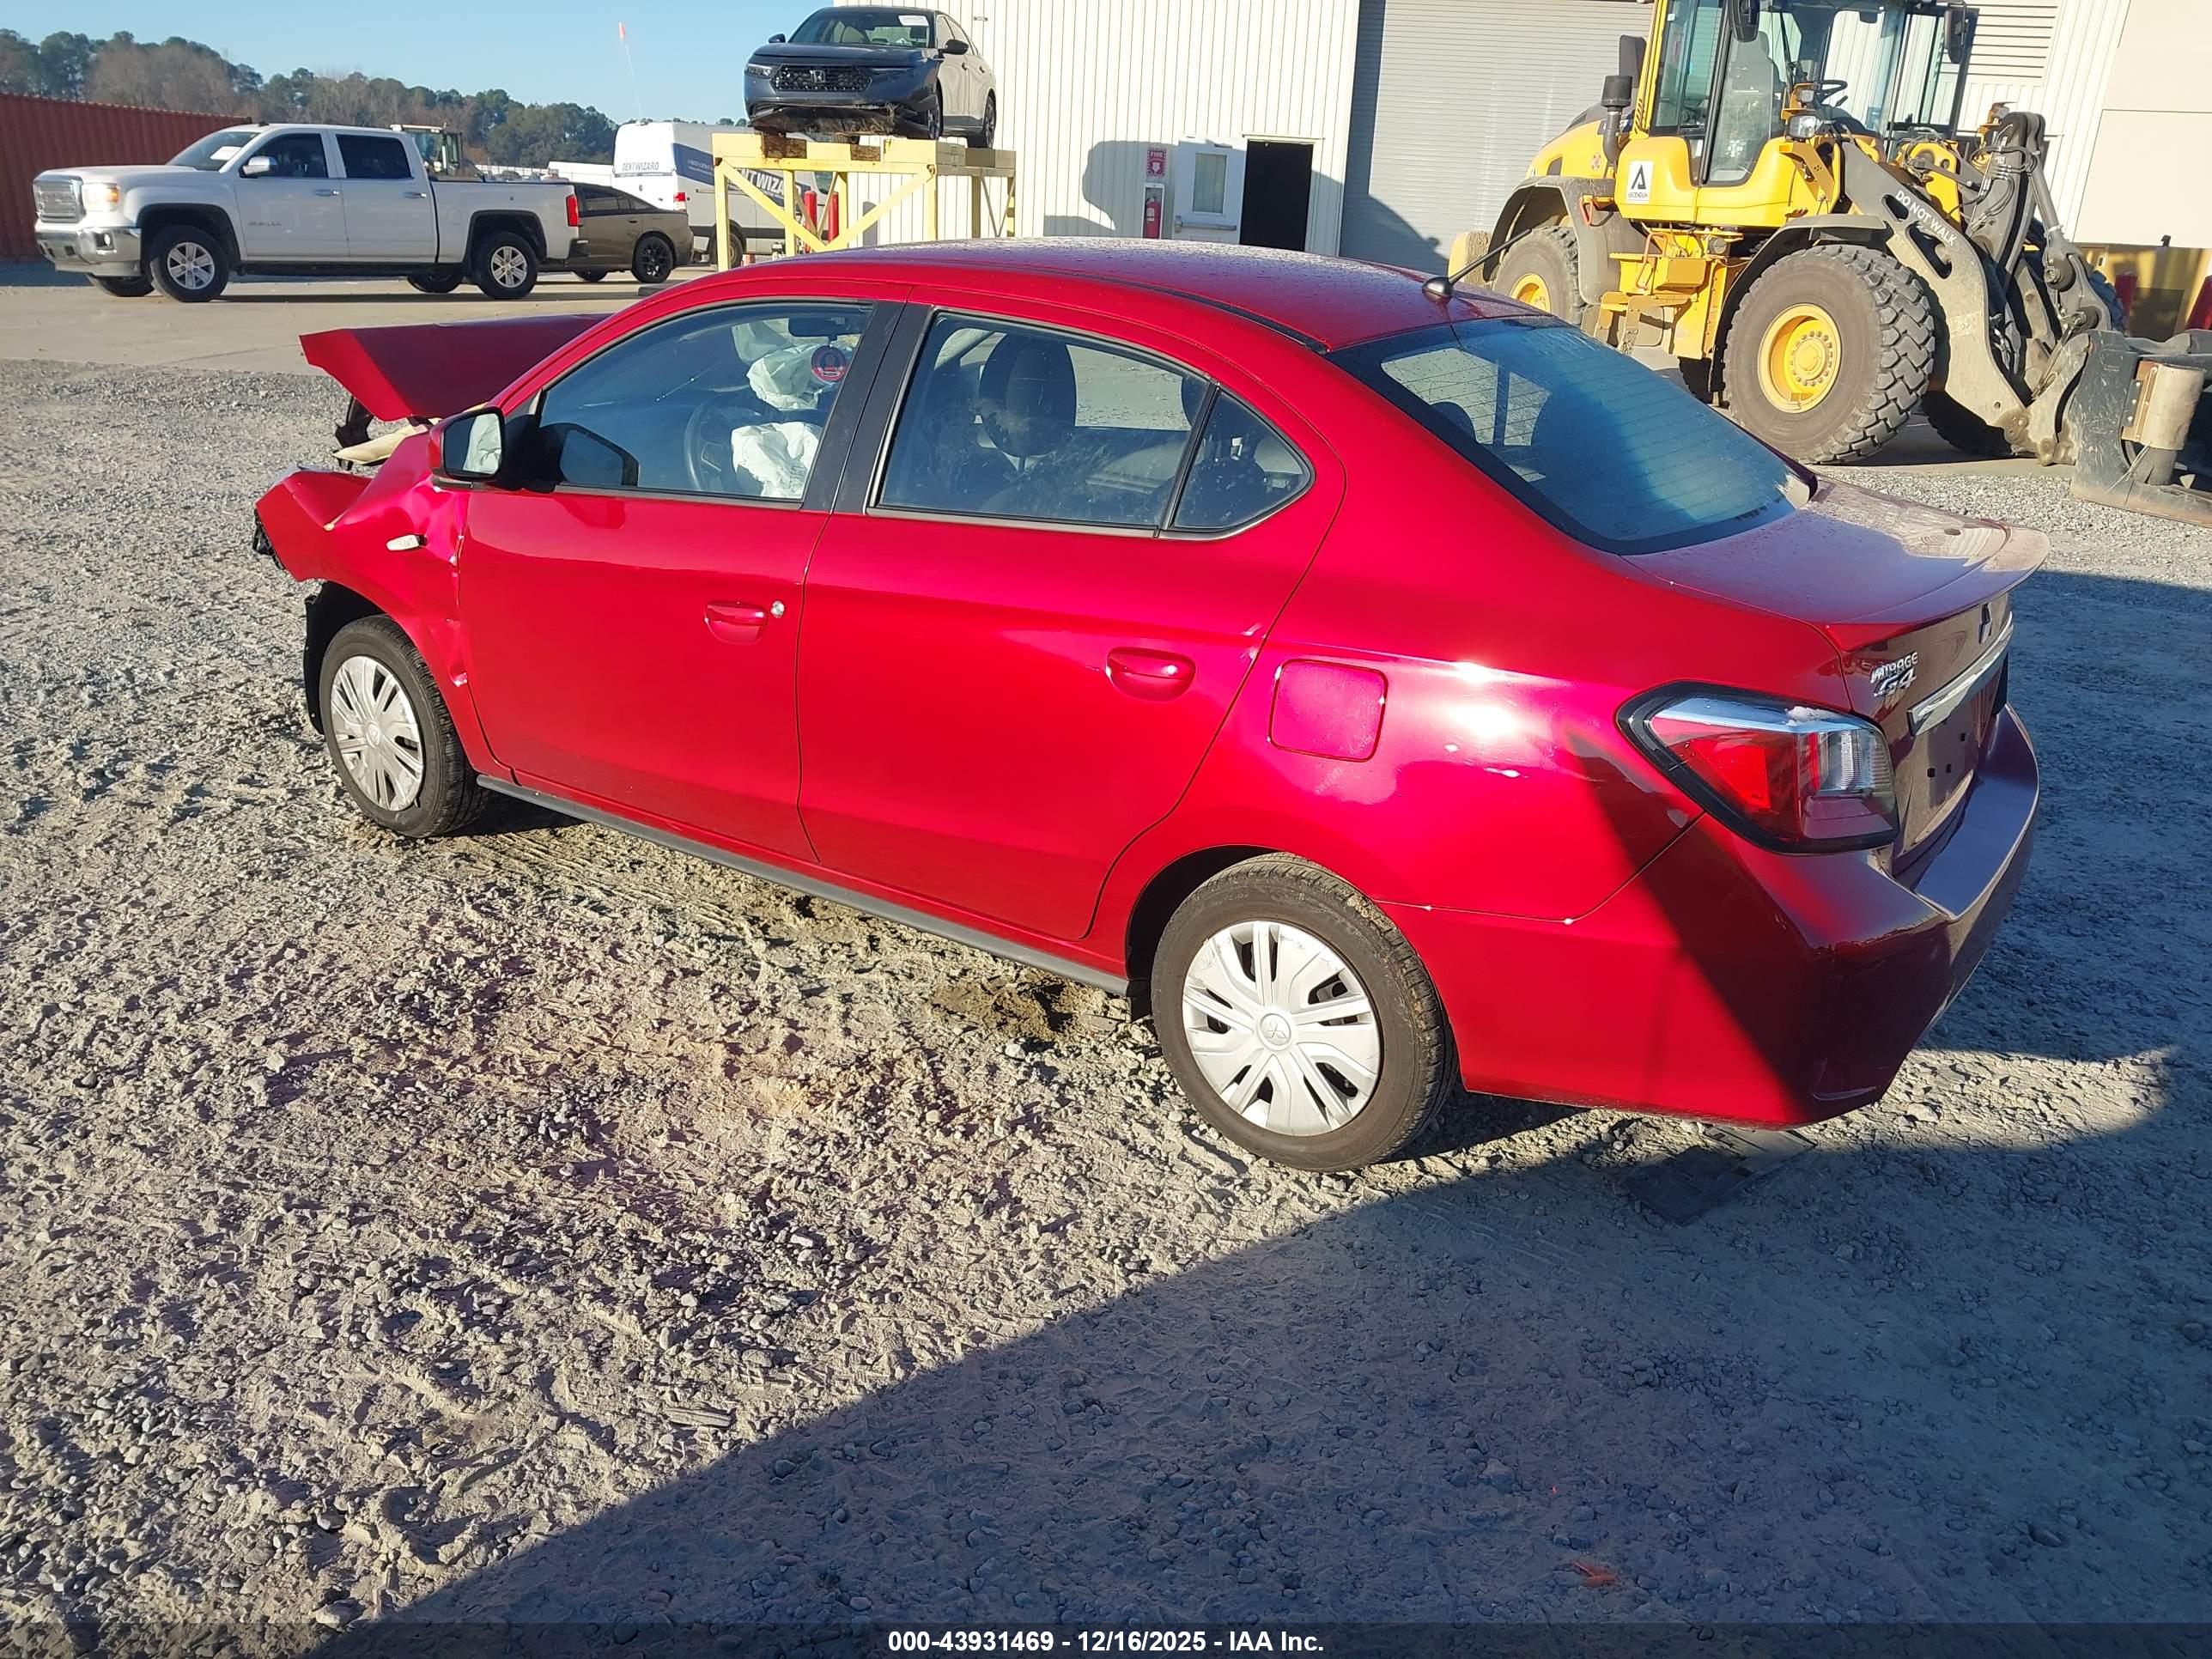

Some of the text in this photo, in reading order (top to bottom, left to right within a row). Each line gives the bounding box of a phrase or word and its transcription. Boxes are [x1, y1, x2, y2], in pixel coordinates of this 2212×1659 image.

[1895, 190, 1957, 246] DO NOT WALK
[1870, 652, 1918, 684] MIRAGE
[1874, 667, 1917, 696] G4
